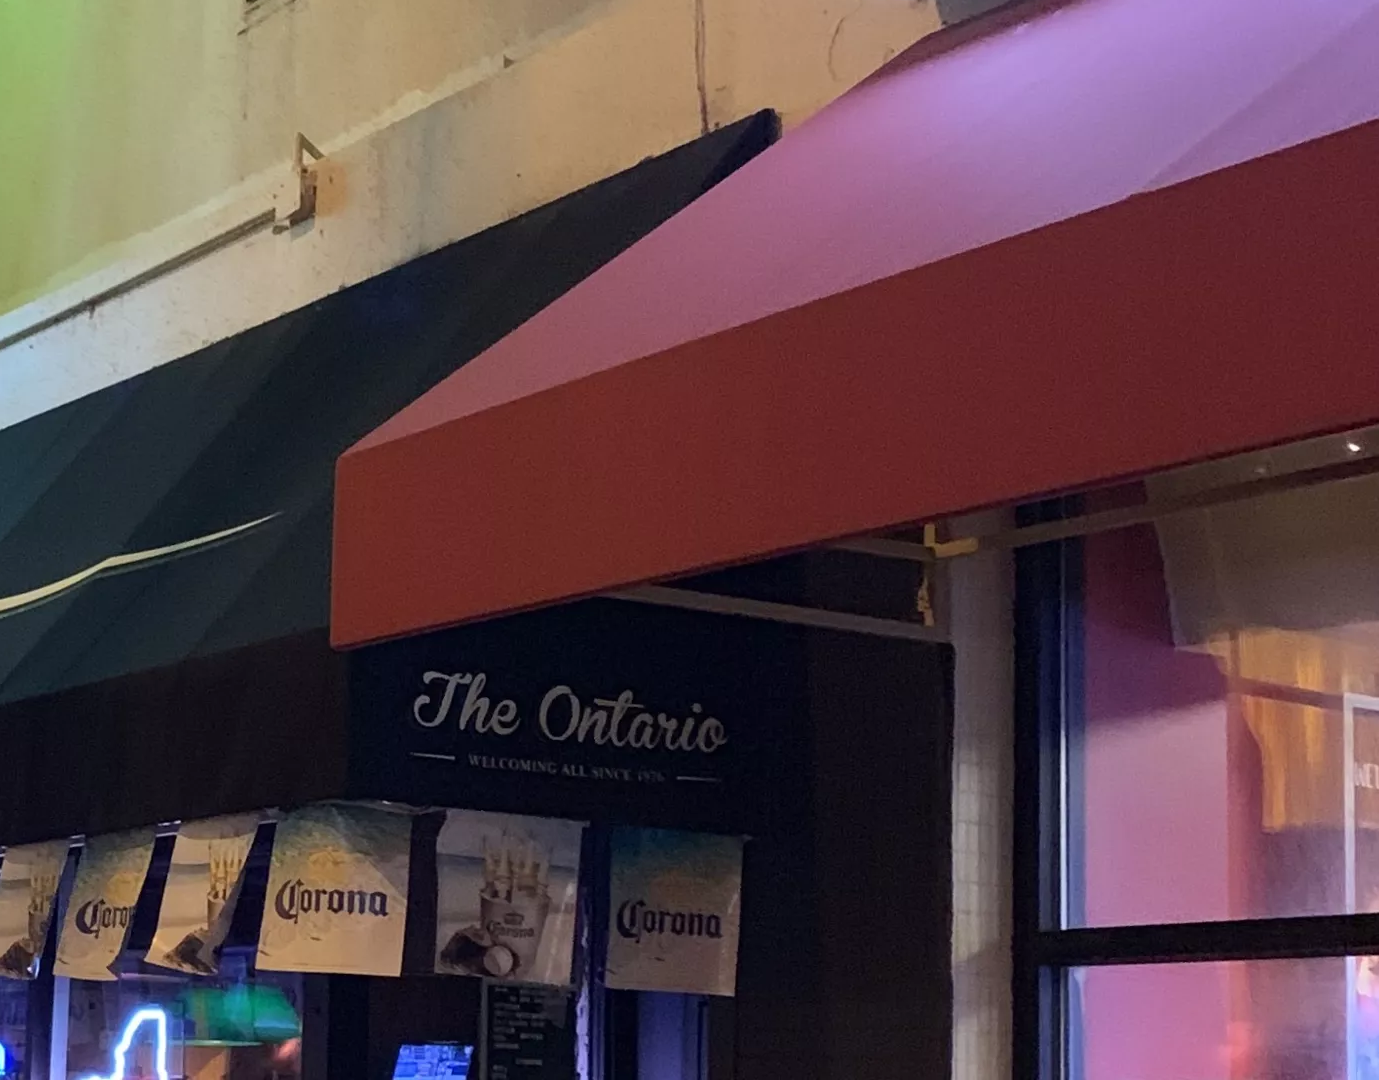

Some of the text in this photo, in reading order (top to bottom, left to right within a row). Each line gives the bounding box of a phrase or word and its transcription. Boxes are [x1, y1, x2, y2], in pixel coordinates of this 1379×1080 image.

[414, 671, 728, 753] The Ontario
[468, 753, 557, 776] WELCOMING
[561, 763, 589, 779] ALL
[592, 767, 632, 782] SINCE
[275, 878, 390, 925] Corona
[617, 900, 724, 944] Corona
